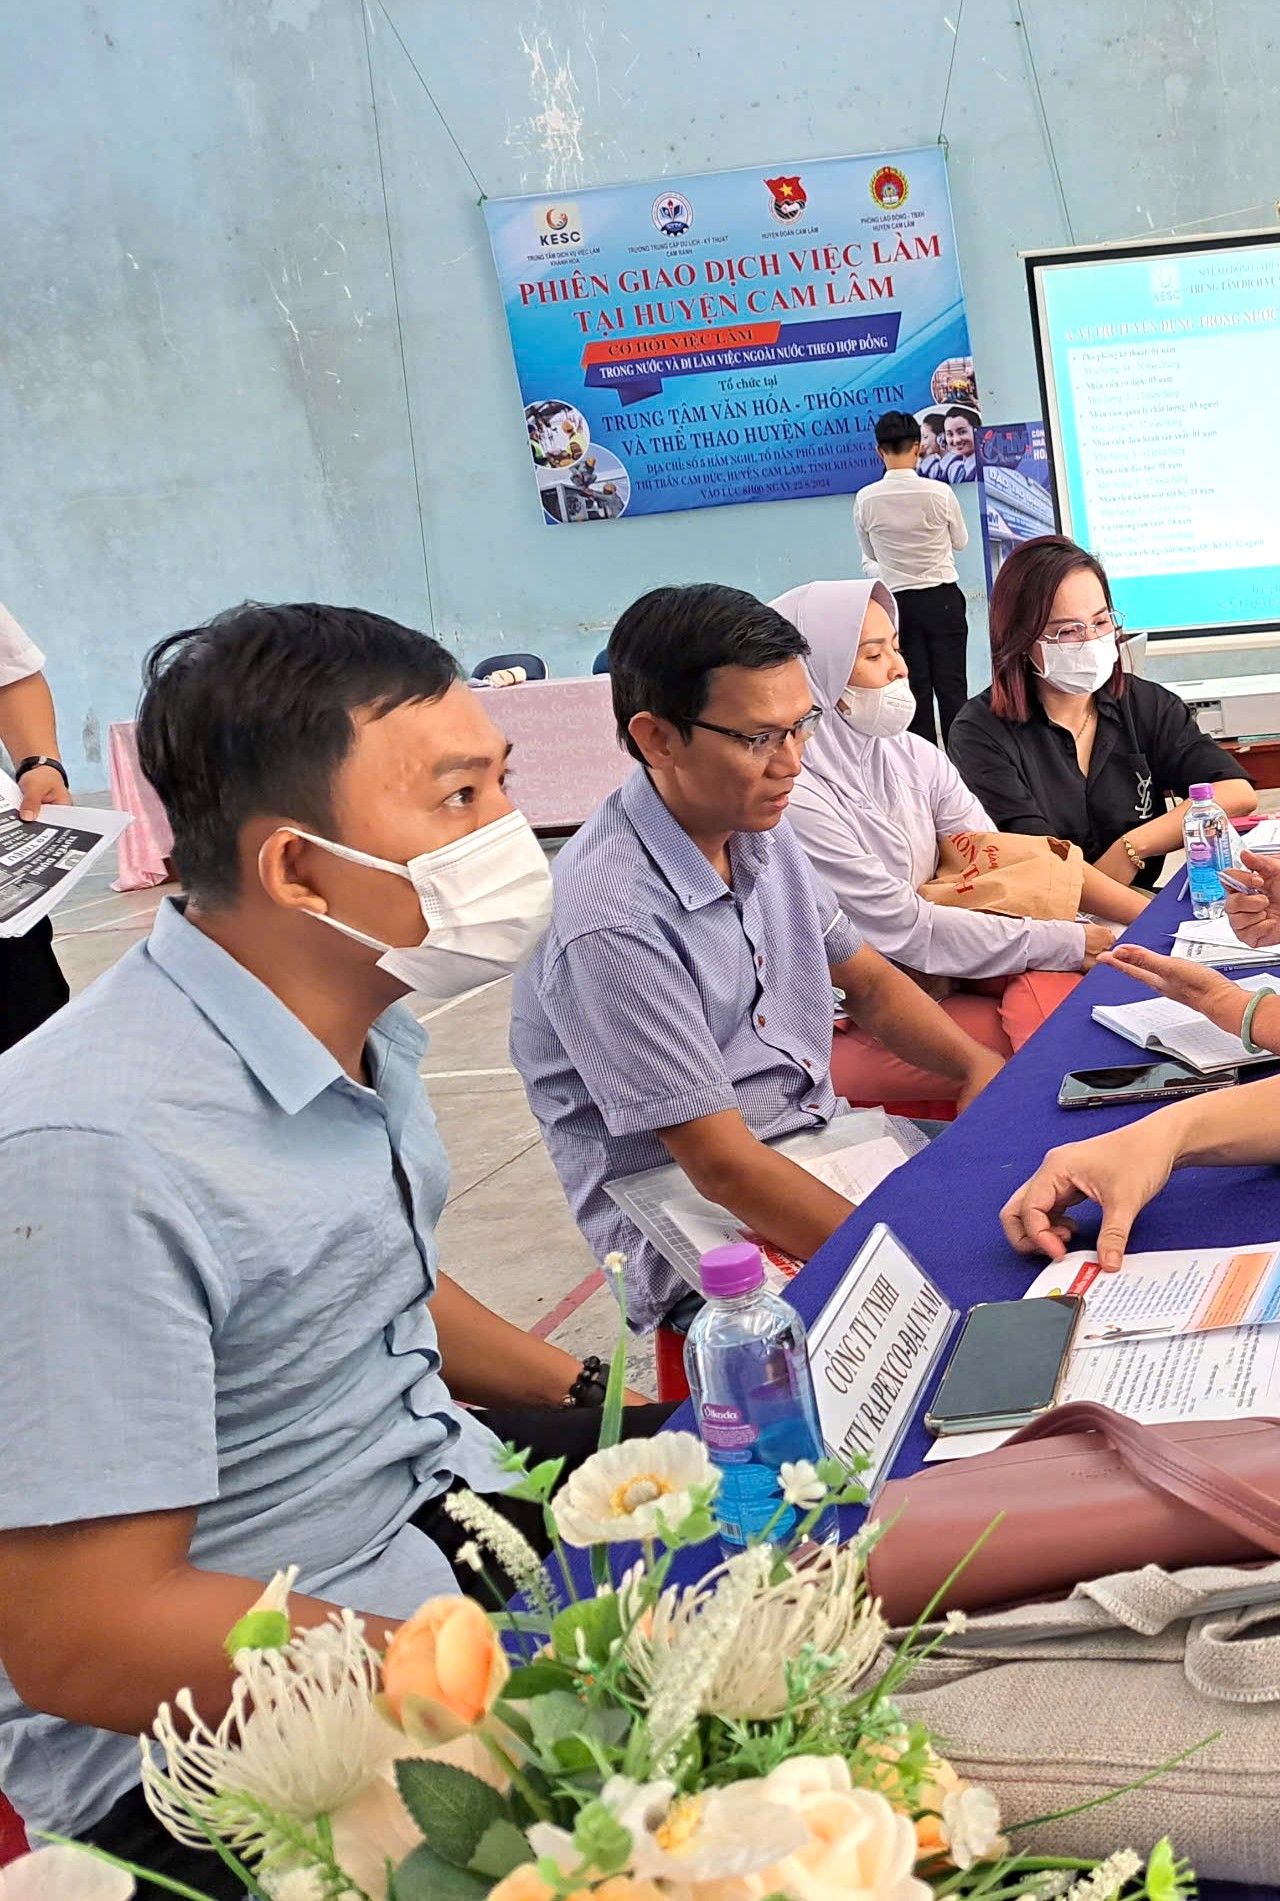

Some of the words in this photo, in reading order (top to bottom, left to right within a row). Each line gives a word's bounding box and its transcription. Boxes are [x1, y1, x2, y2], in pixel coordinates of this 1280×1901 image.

[540, 231, 581, 246] KESC
[519, 269, 609, 305] PHIÊN
[619, 263, 695, 293] GIAO
[705, 253, 780, 287] DỊCH
[789, 244, 863, 276] VIỆC
[872, 232, 941, 264] LÀM
[573, 306, 624, 336] TẠI
[634, 292, 738, 325] HUYỆN
[747, 284, 817, 314] CAM
[825, 272, 895, 305] LÂM
[600, 364, 635, 379] TRONG
[636, 360, 664, 376] NƯỚC
[666, 356, 681, 372] VÀ
[681, 357, 693, 370] ĐI
[693, 354, 714, 368] LÀM
[714, 350, 742, 367] VIỆC
[743, 346, 777, 363] NGOÀI
[777, 343, 806, 359] NƯỚC
[806, 341, 836, 356] THEO
[837, 338, 859, 354] HỢP
[859, 333, 888, 349] ĐỒNG
[609, 343, 632, 356] CƠ
[637, 338, 666, 355] HỘI
[670, 333, 711, 350] VIỆC
[716, 329, 753, 344] LÀM
[736, 376, 761, 389] chức
[764, 375, 778, 387] tại
[602, 409, 665, 433] TRUNG
[668, 402, 707, 425] TÂM
[710, 397, 747, 420] VĂN
[752, 393, 791, 416] HÓA
[804, 385, 869, 411] THÔNG
[872, 385, 905, 403] TIN
[622, 434, 647, 456] VÀ
[650, 424, 687, 453] THỂ
[690, 429, 740, 449] THAO
[744, 418, 806, 444] HUYỆN
[811, 417, 850, 437] CAM
[854, 410, 884, 432] LÂ
[8, 844, 36, 862] TRIỆU
[37, 835, 49, 844] 10
[53, 835, 79, 858] TUYỂN
[29, 857, 56, 876] DỤNG
[863, 1273, 900, 1330] TNHH
[911, 1283, 943, 1330] NAM
[849, 1312, 878, 1350] TY
[824, 1336, 866, 1394] CÔNG
